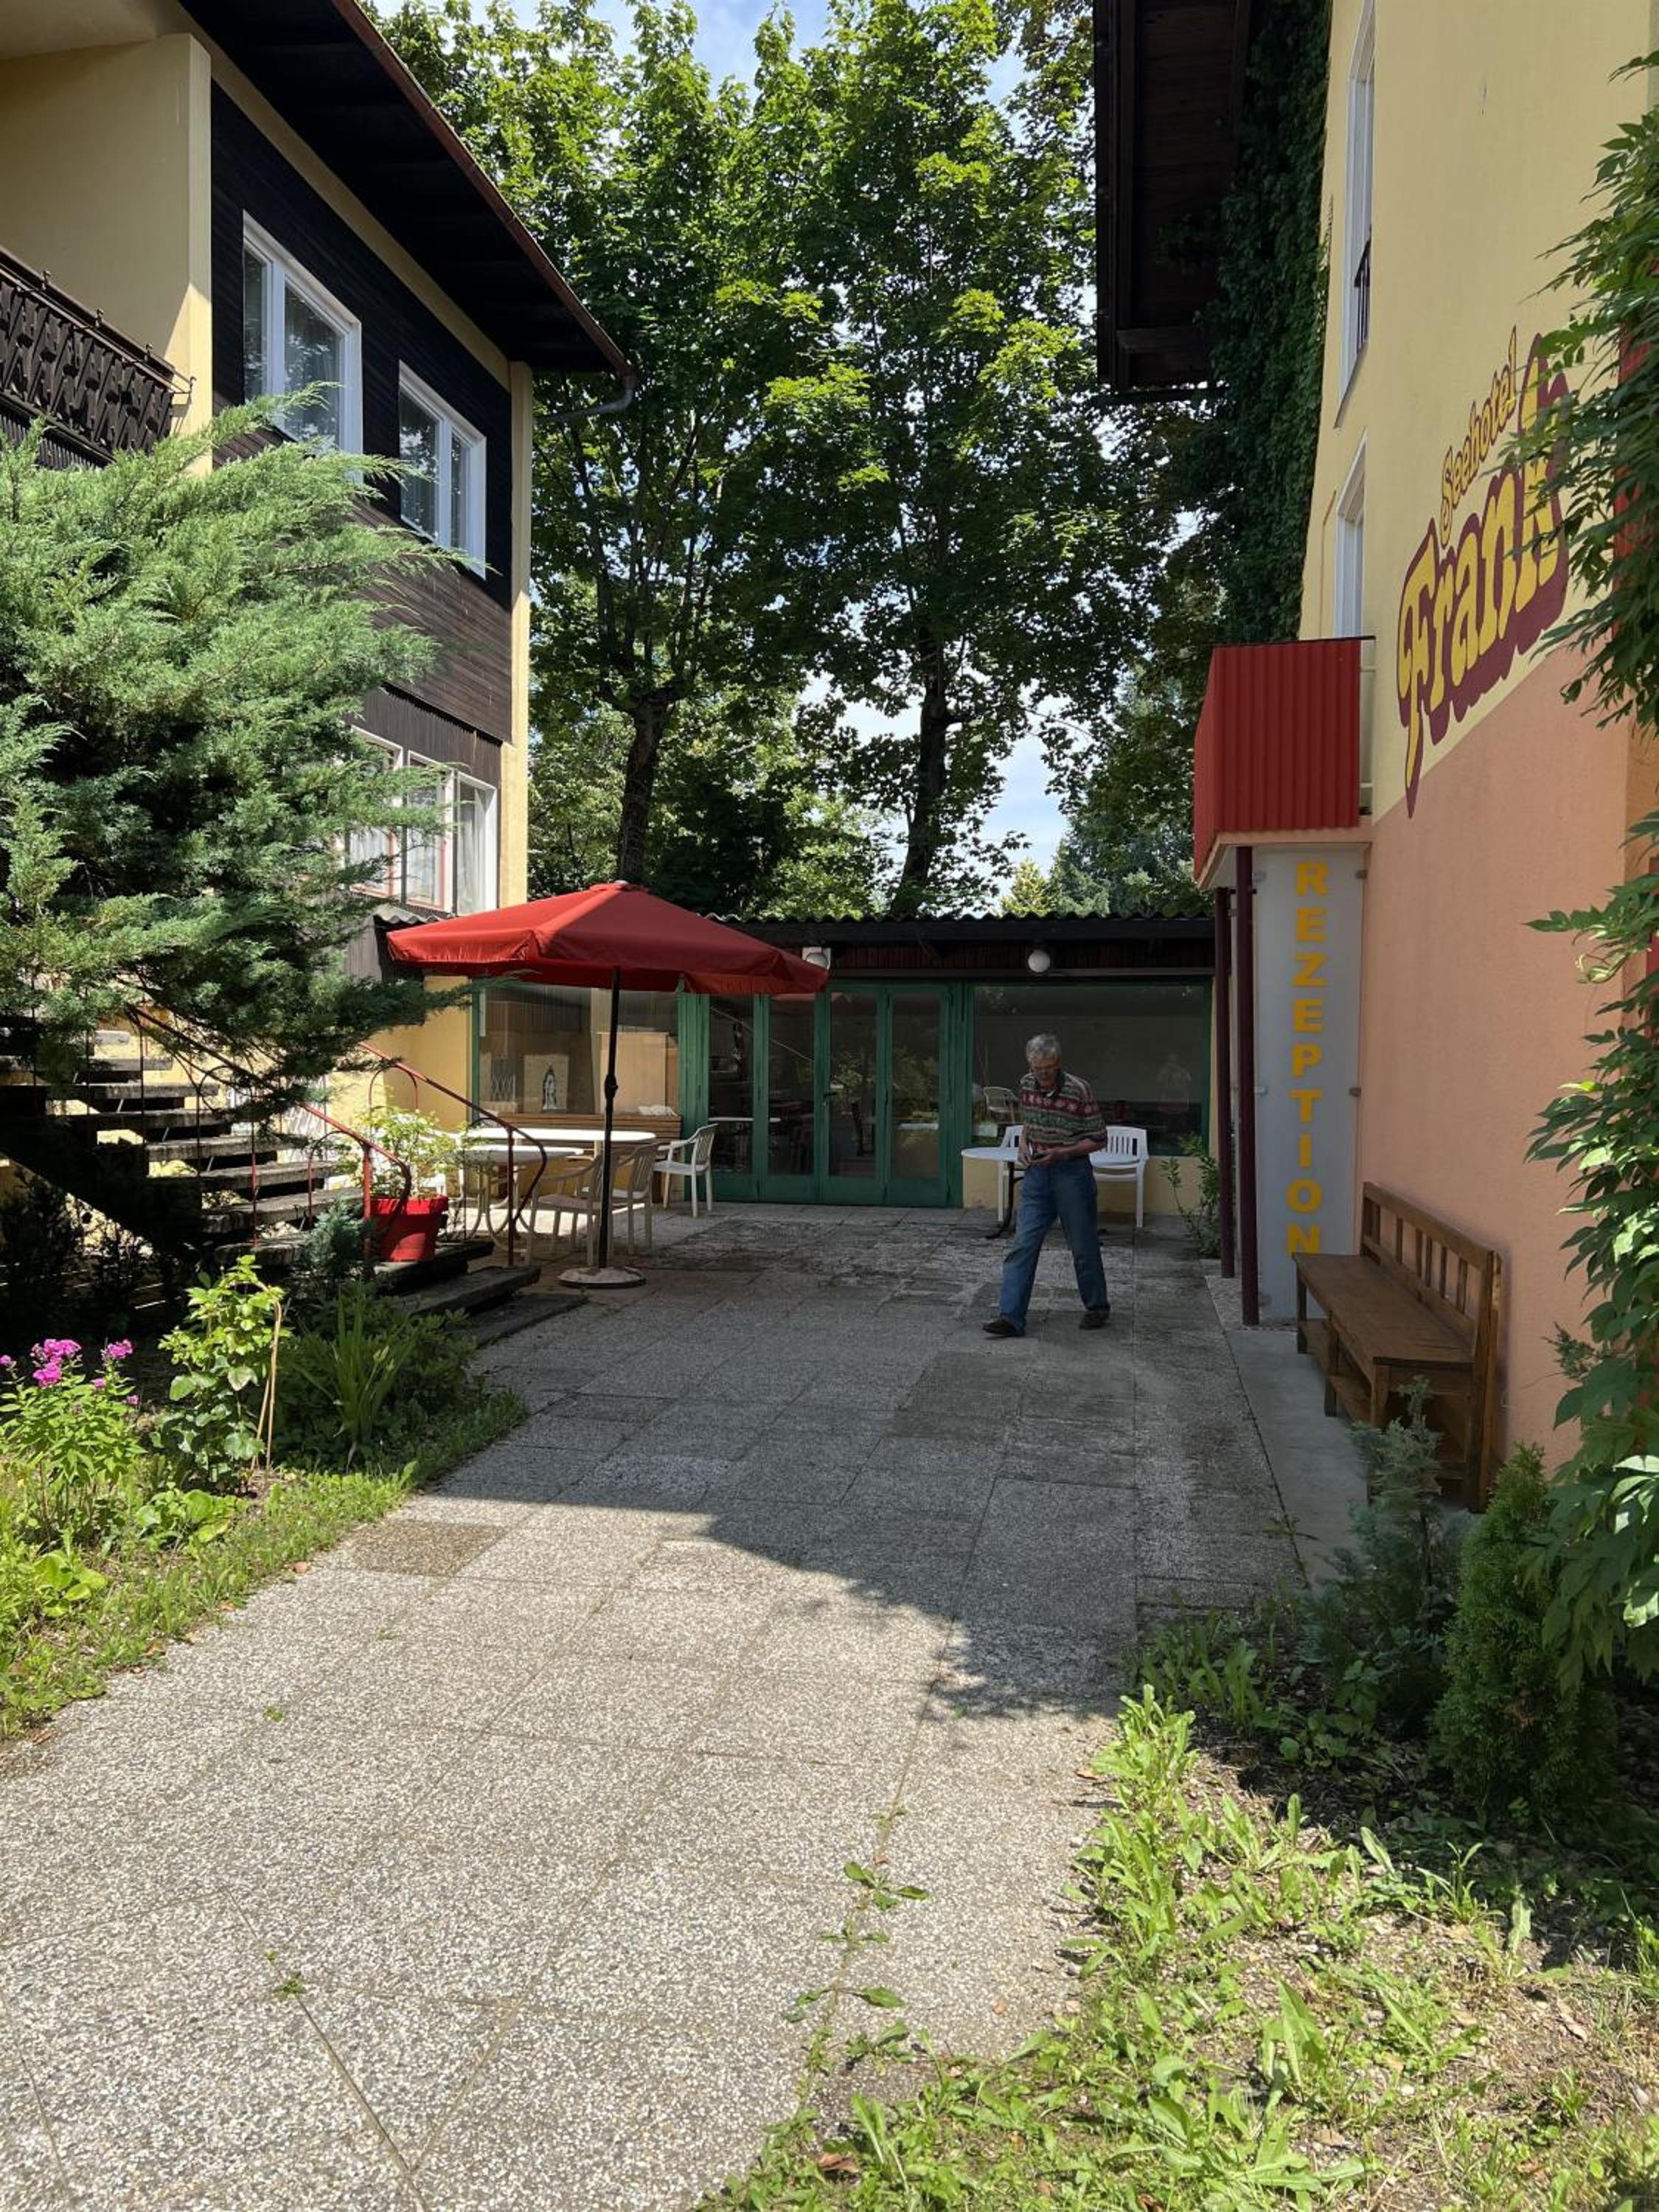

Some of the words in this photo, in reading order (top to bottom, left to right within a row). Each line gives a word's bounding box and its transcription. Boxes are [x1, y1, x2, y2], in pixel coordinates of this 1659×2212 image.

[1397, 334, 1568, 817] Frank
[1440, 324, 1517, 549] Seehotel
[1286, 862, 1329, 1254] REZEPTION
